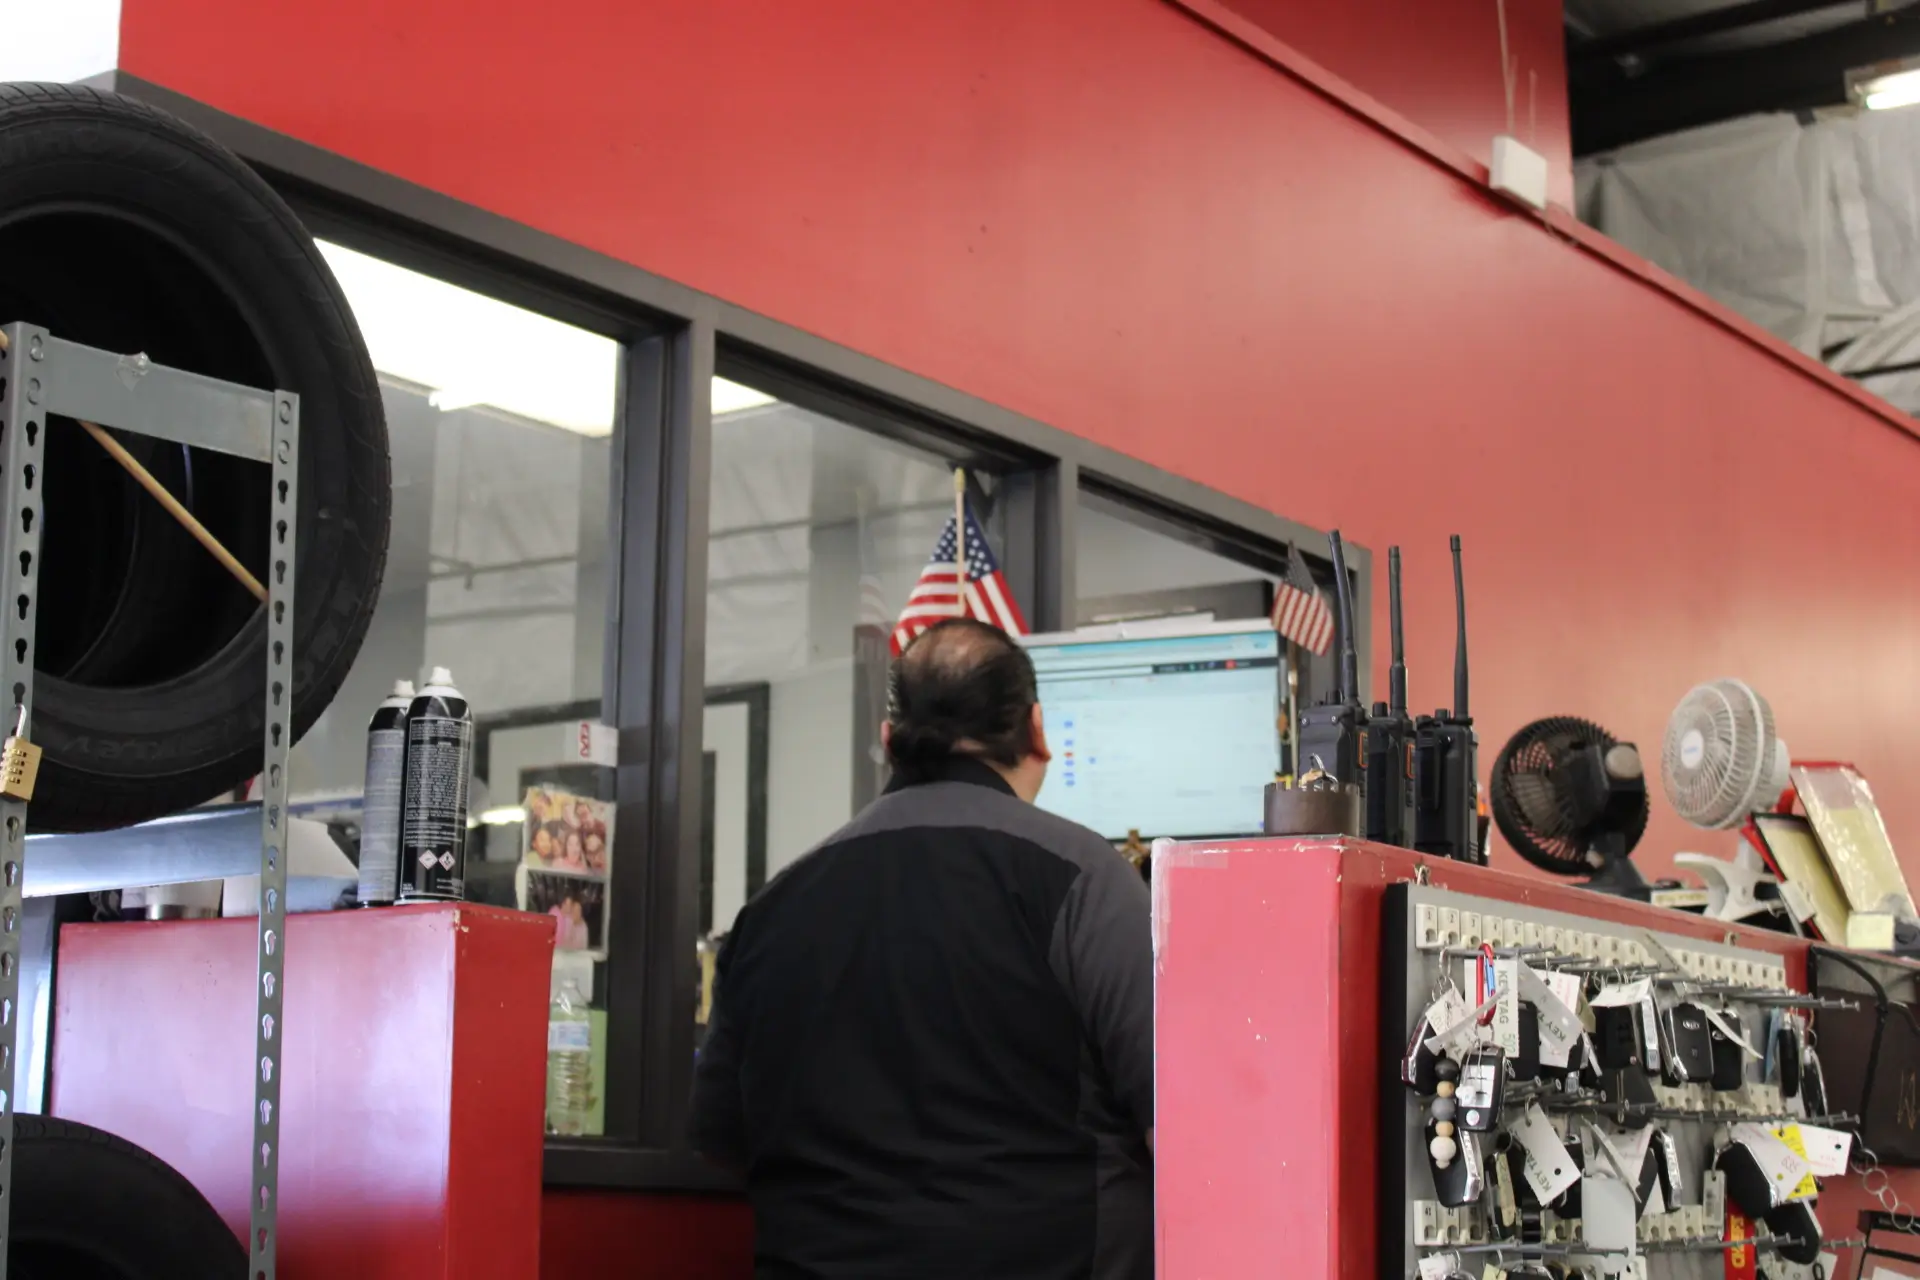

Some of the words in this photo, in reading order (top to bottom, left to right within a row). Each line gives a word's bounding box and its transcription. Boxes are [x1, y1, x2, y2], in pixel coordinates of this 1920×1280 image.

[1498, 1000, 1509, 1025] TAG
[1546, 1018, 1566, 1042] KEY
[1534, 1170, 1552, 1193] KEY
